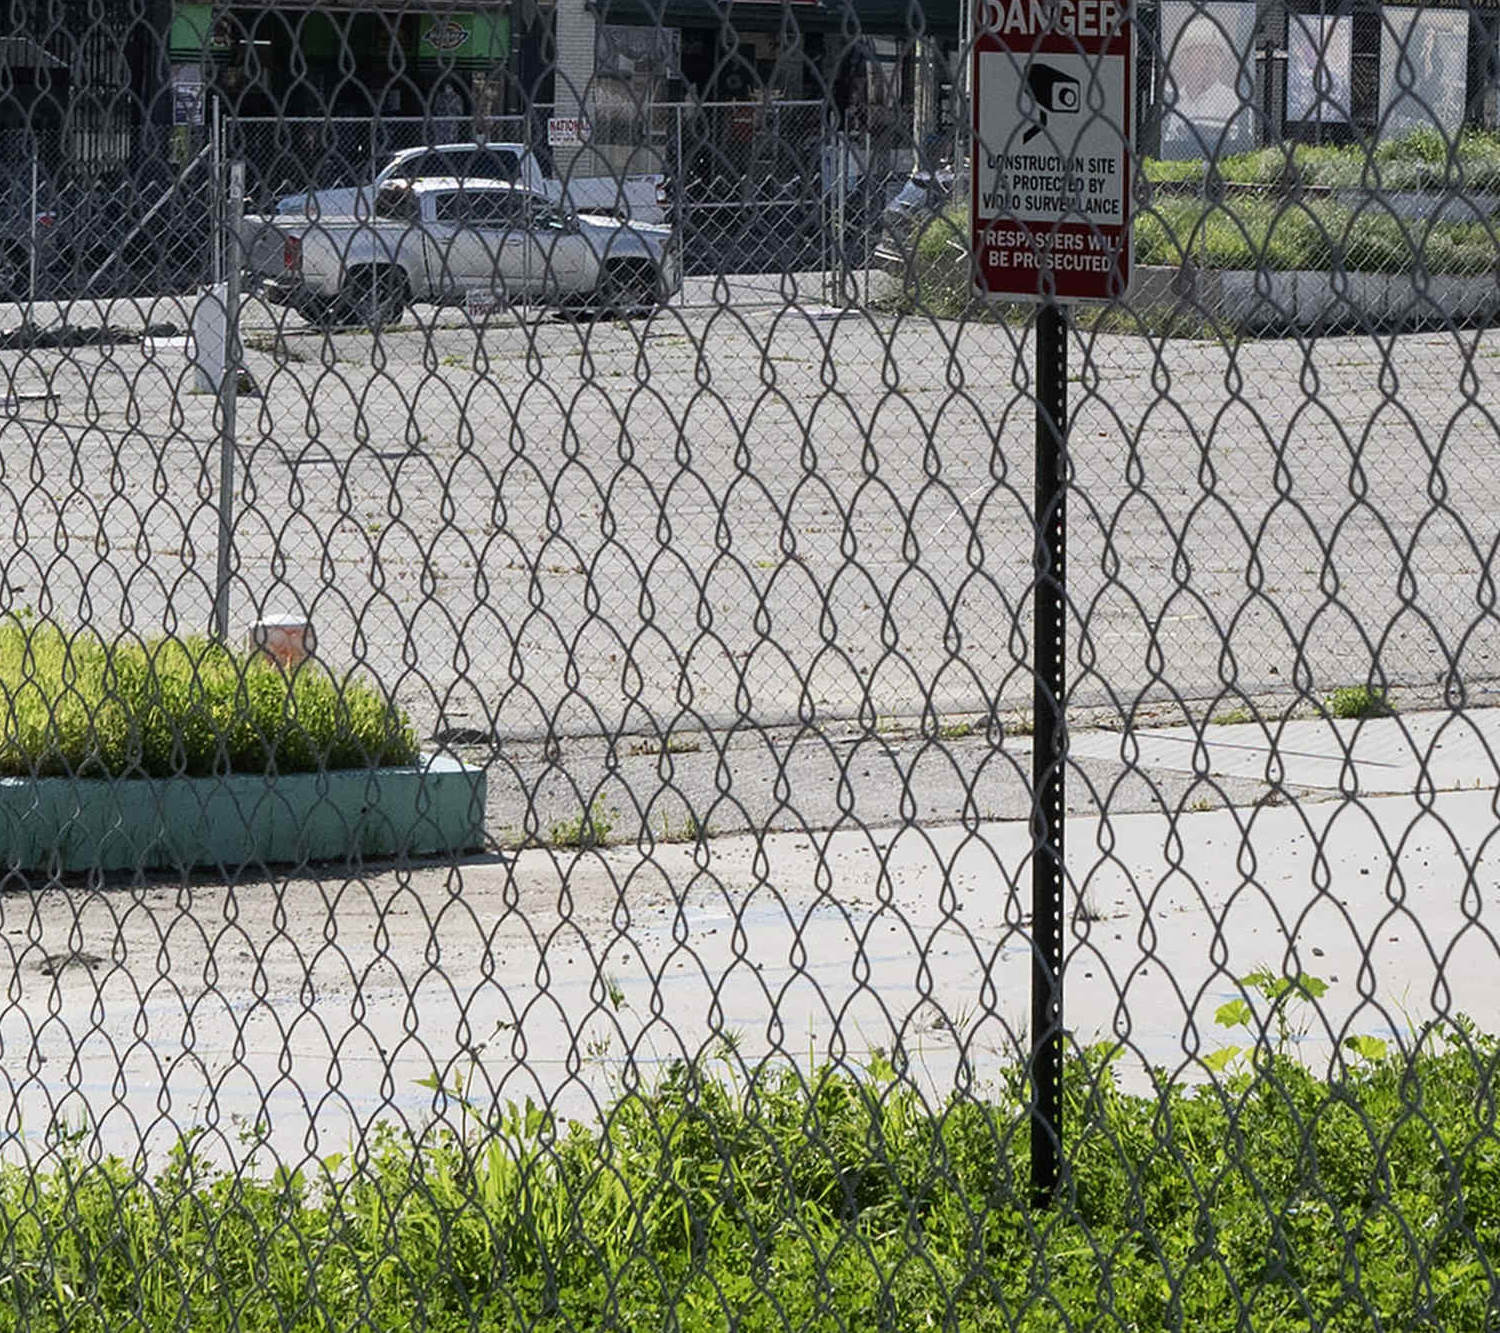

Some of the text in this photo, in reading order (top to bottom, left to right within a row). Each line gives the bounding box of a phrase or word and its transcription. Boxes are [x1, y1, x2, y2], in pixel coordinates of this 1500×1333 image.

[1088, 158, 1115, 174] SITE
[1013, 175, 1084, 192] PROTECED
[1089, 178, 1106, 194] BY
[1025, 195, 1120, 214] SURVELANCE
[989, 250, 1112, 272] BE PROSECUTED
